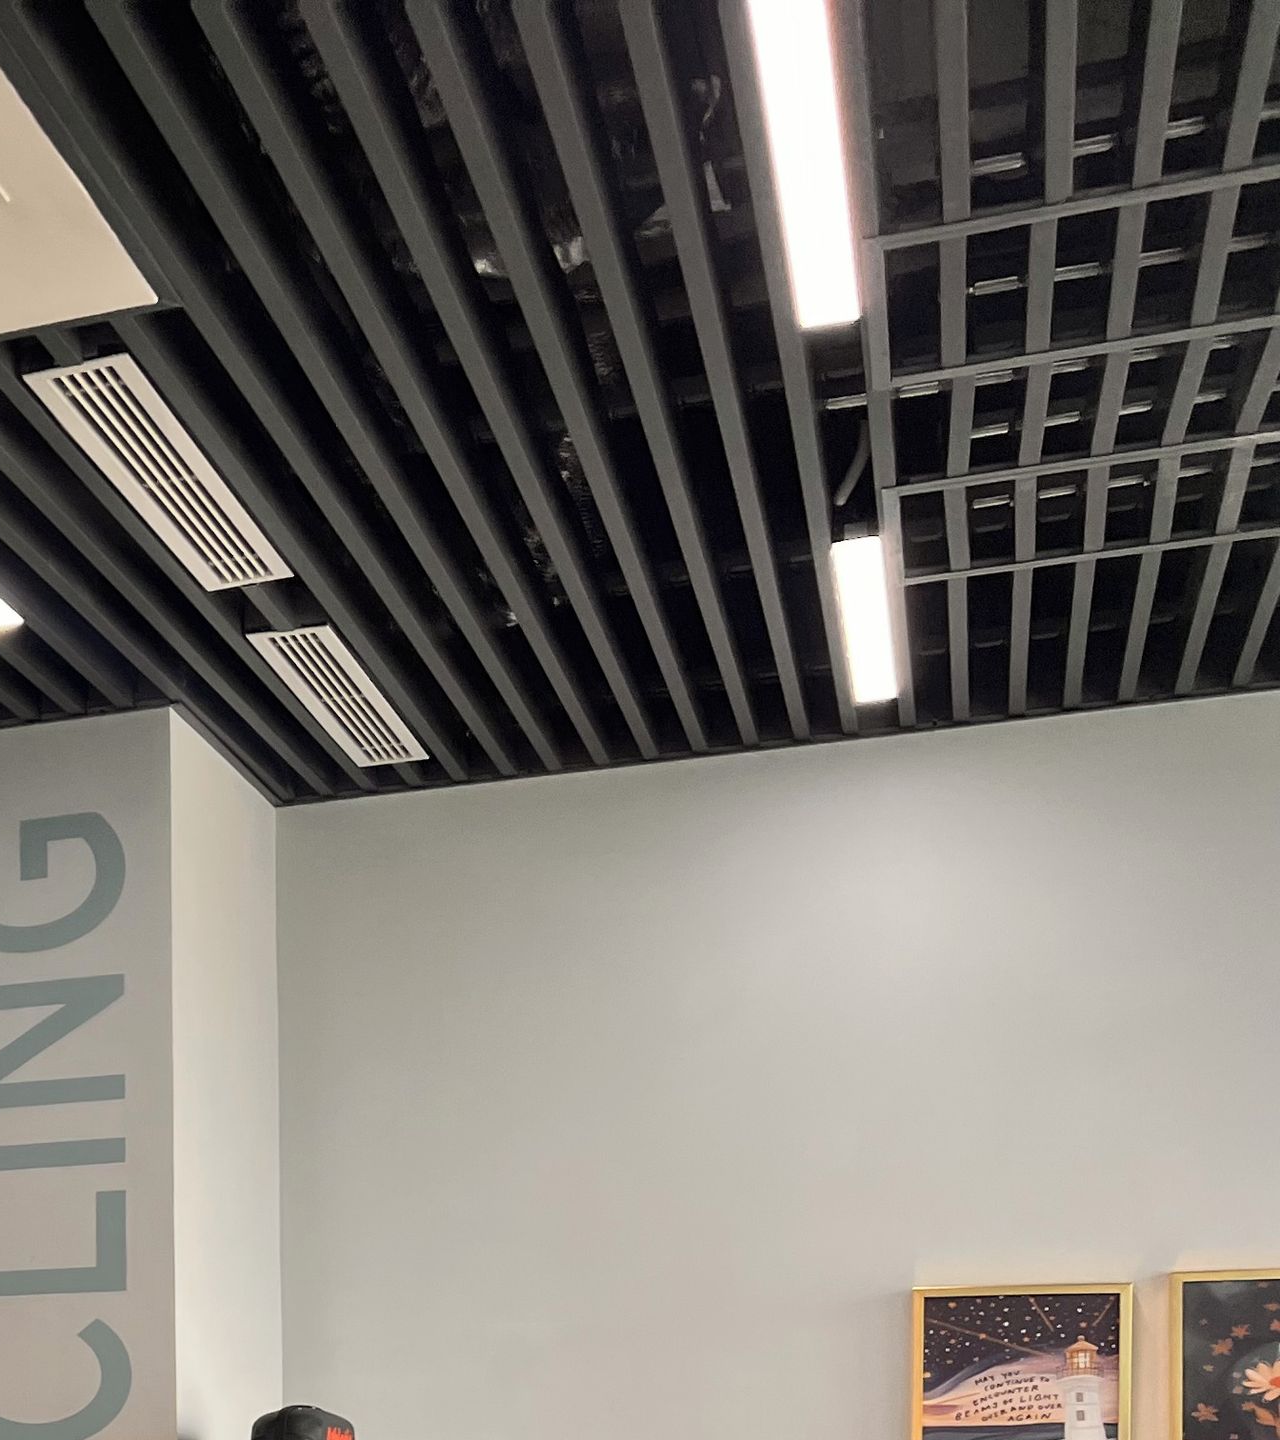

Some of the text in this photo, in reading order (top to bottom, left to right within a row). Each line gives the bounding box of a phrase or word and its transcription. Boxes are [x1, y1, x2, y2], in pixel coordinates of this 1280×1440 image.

[974, 1370, 1021, 1386] MAY YOU
[984, 1376, 1036, 1392] CONTINUE
[972, 1384, 1040, 1406] ENCOUNTER
[1019, 1393, 1059, 1403] LIGHT
[1007, 1413, 1052, 1422] AGAIN
